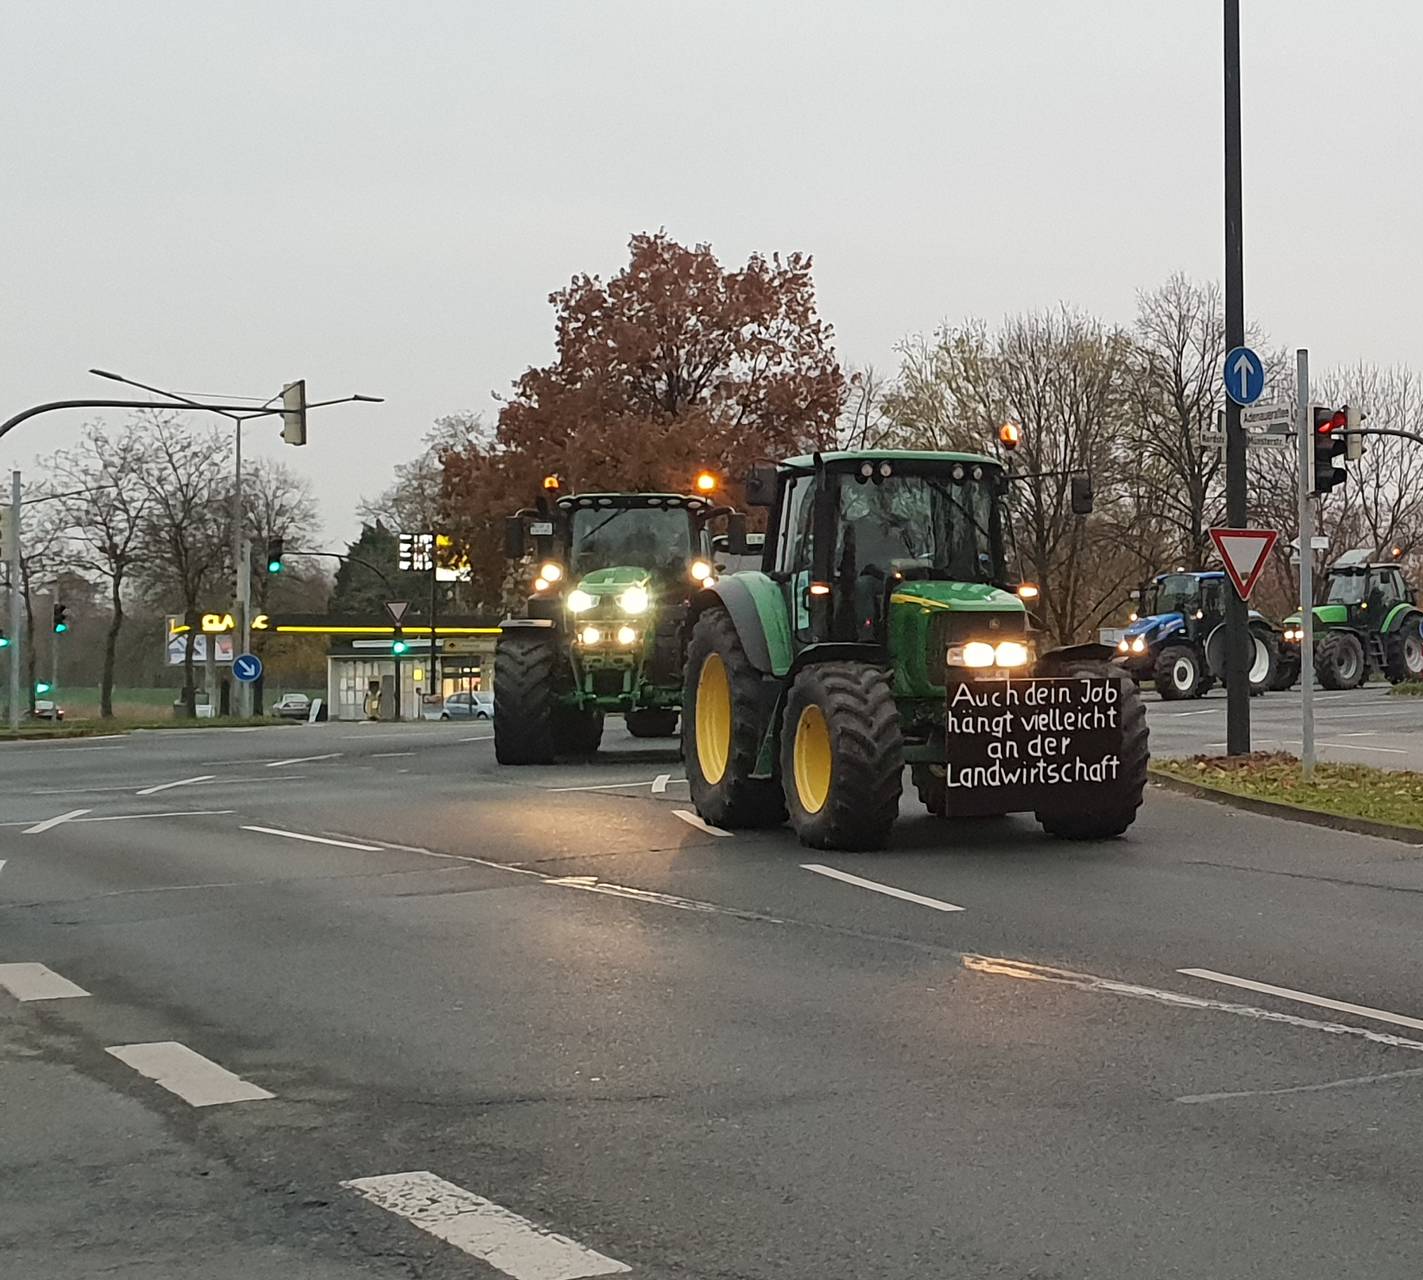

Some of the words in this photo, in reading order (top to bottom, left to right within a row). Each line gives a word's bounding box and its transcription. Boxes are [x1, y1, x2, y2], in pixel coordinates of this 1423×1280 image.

[951, 680, 1019, 707] Auch
[1024, 680, 1071, 706] dein
[1080, 679, 1118, 703] Job
[948, 709, 1014, 738] hängt
[1020, 706, 1118, 732] vielleicht
[987, 740, 1019, 760] an
[1027, 734, 1071, 757] der
[947, 754, 1121, 788] Landwirtschaft
